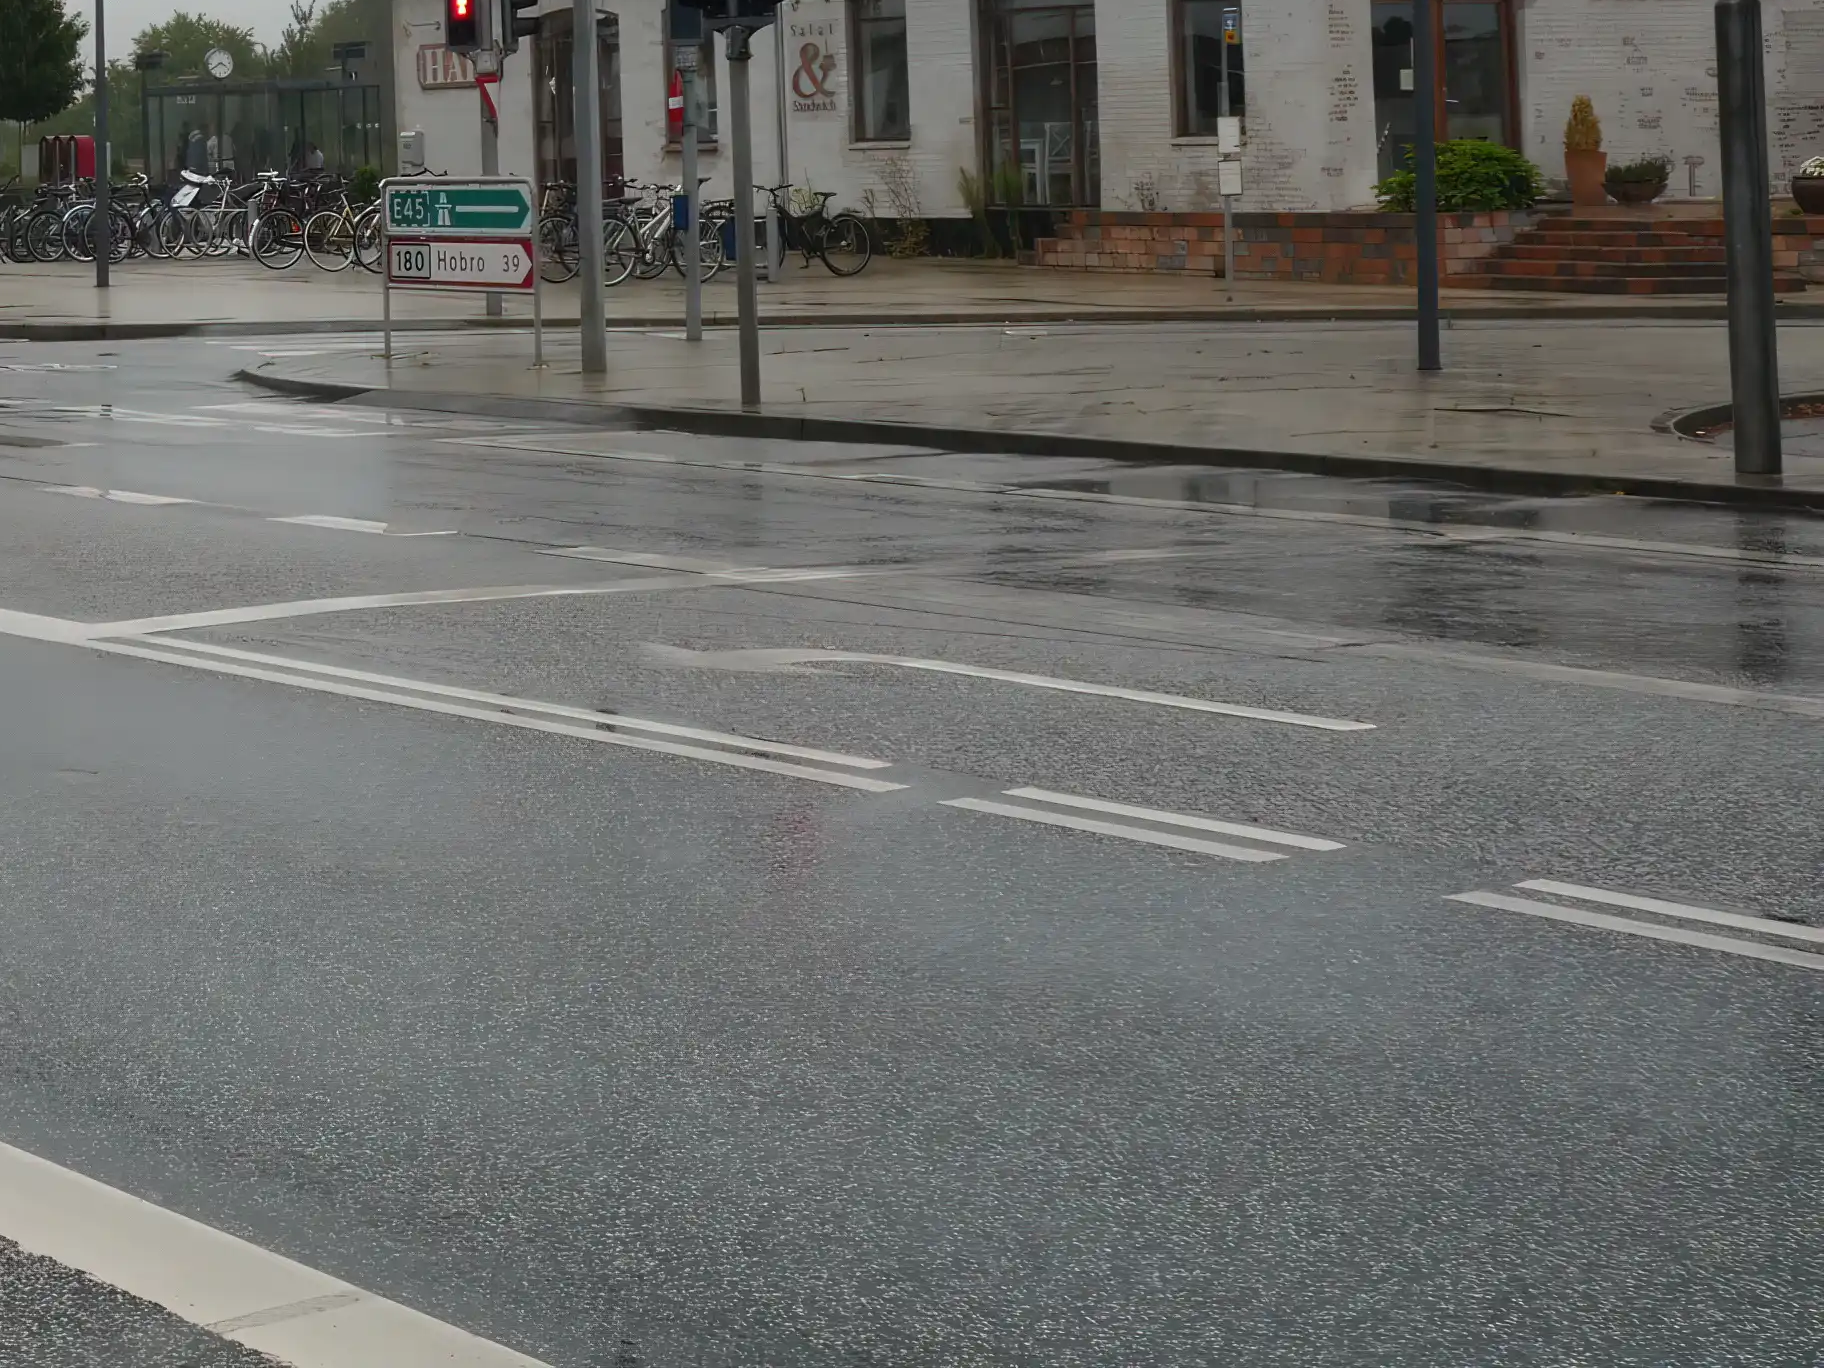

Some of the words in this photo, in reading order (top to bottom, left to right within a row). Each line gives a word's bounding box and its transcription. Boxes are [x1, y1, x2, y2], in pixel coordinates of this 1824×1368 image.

[792, 42, 836, 98] &
[393, 198, 424, 220] E45
[396, 250, 424, 271] 180
[437, 250, 485, 272] Hobro
[502, 254, 520, 273] 39
